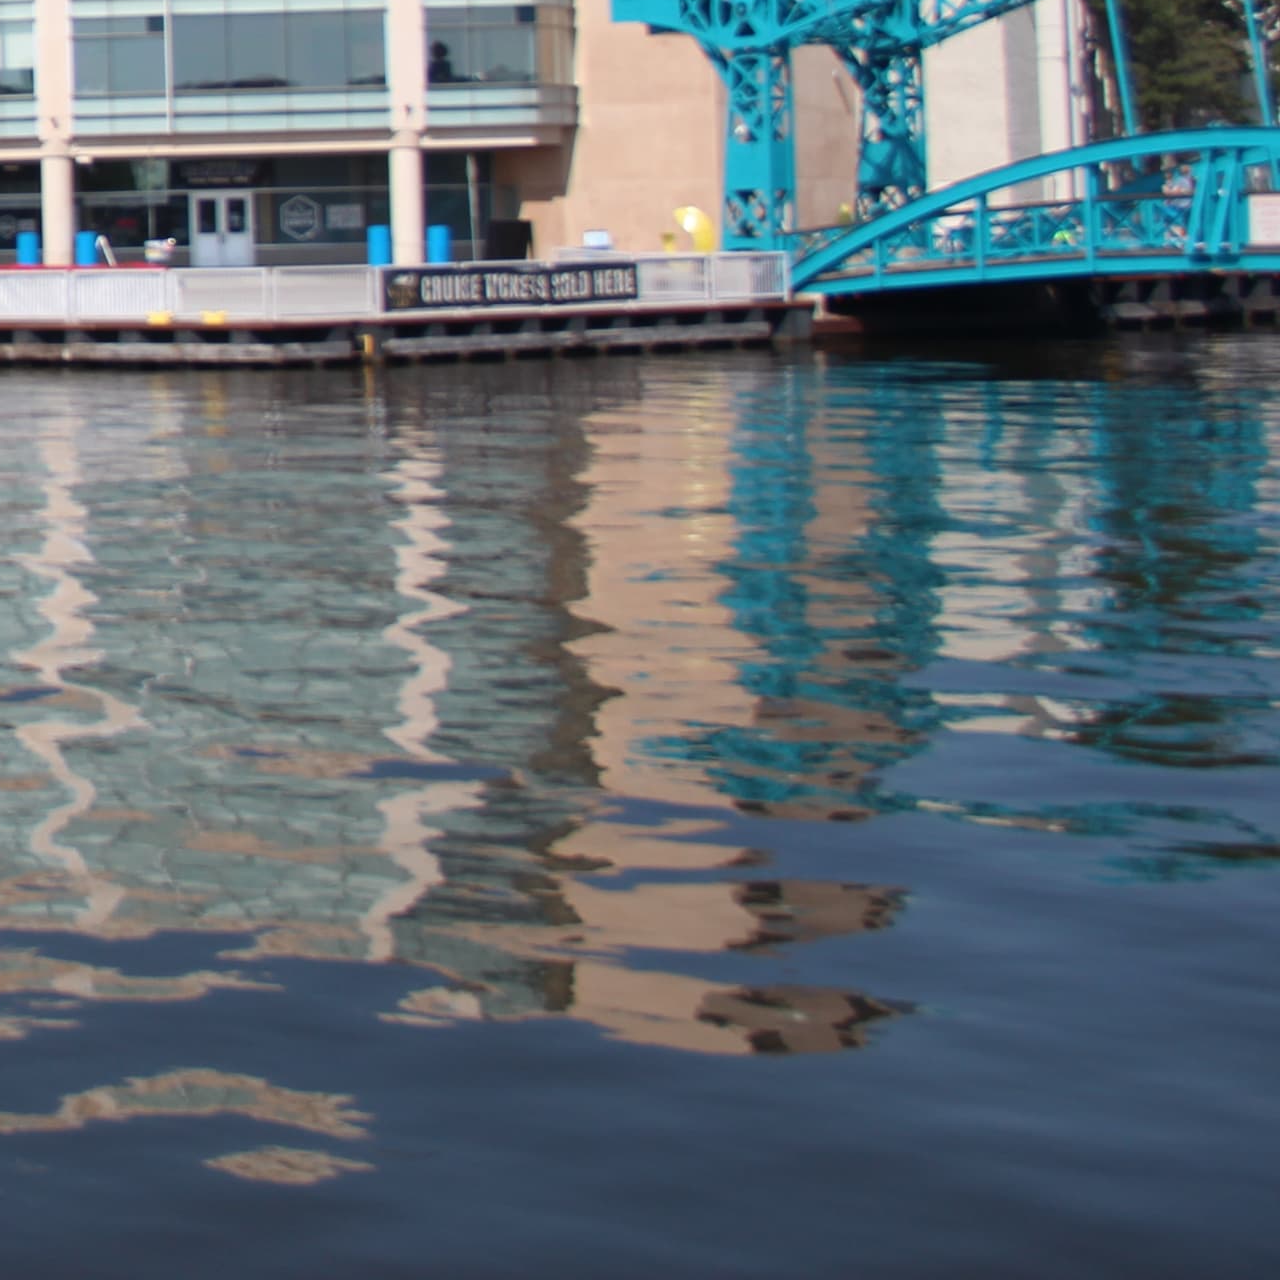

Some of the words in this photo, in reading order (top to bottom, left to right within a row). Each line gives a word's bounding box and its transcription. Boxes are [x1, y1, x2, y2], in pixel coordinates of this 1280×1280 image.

[421, 274, 481, 303] CRUISE
[483, 272, 549, 301] TICKETS
[551, 270, 592, 300] SOLD
[593, 267, 635, 296] HERE
